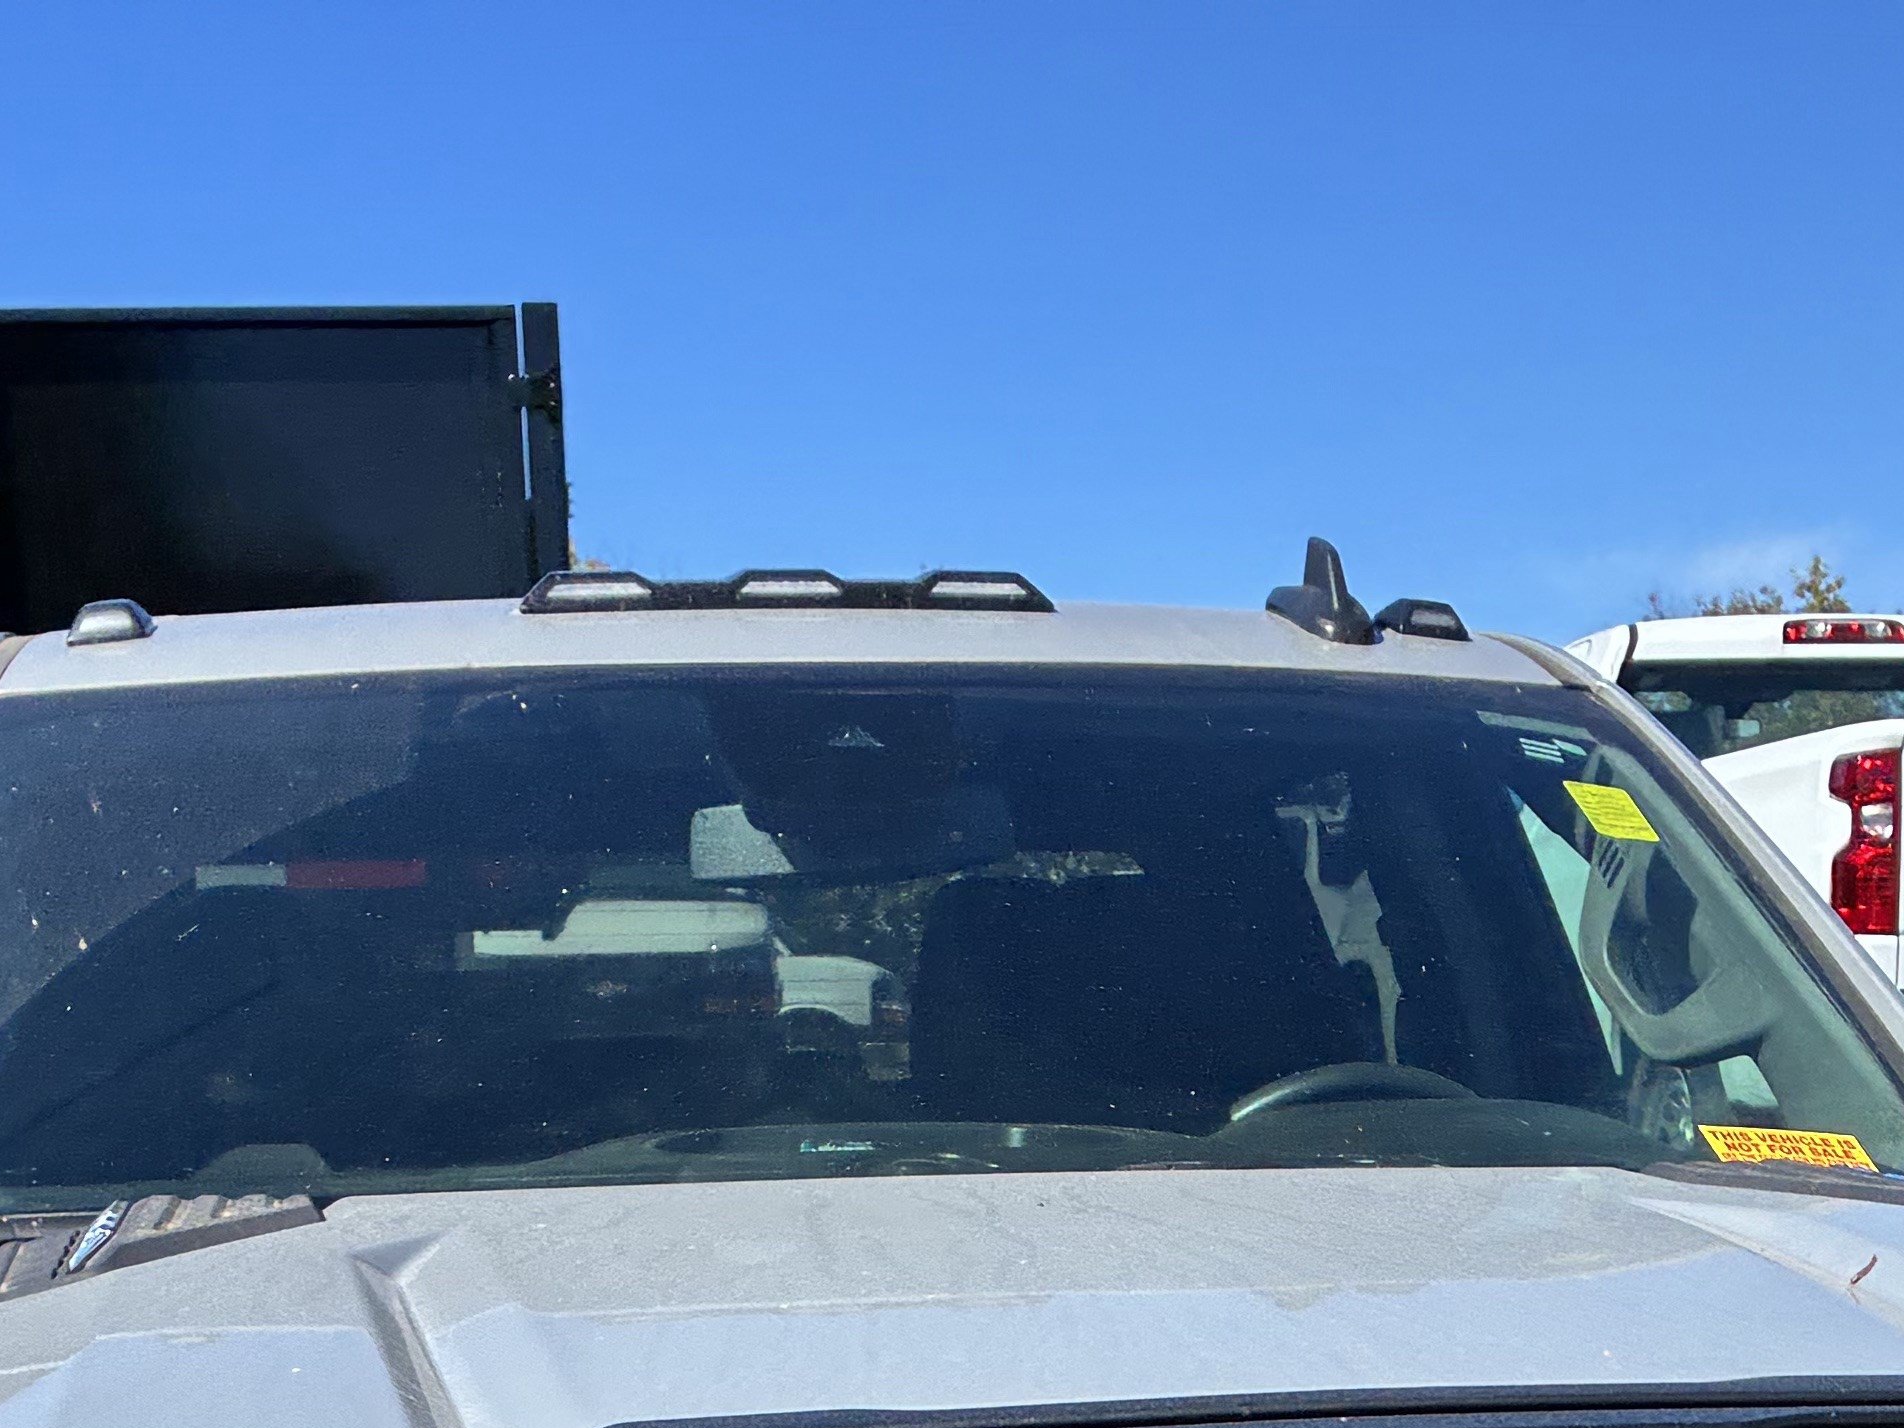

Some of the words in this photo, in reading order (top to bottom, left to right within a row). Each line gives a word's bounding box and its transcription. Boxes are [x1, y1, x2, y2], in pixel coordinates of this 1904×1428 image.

[1707, 1130, 1753, 1143] THIS
[1754, 1131, 1834, 1148] VEHICLE
[1836, 1138, 1858, 1150] IS
[1724, 1141, 1763, 1154] NOT
[1767, 1143, 1807, 1157] FOR
[1810, 1147, 1858, 1161] SALE
